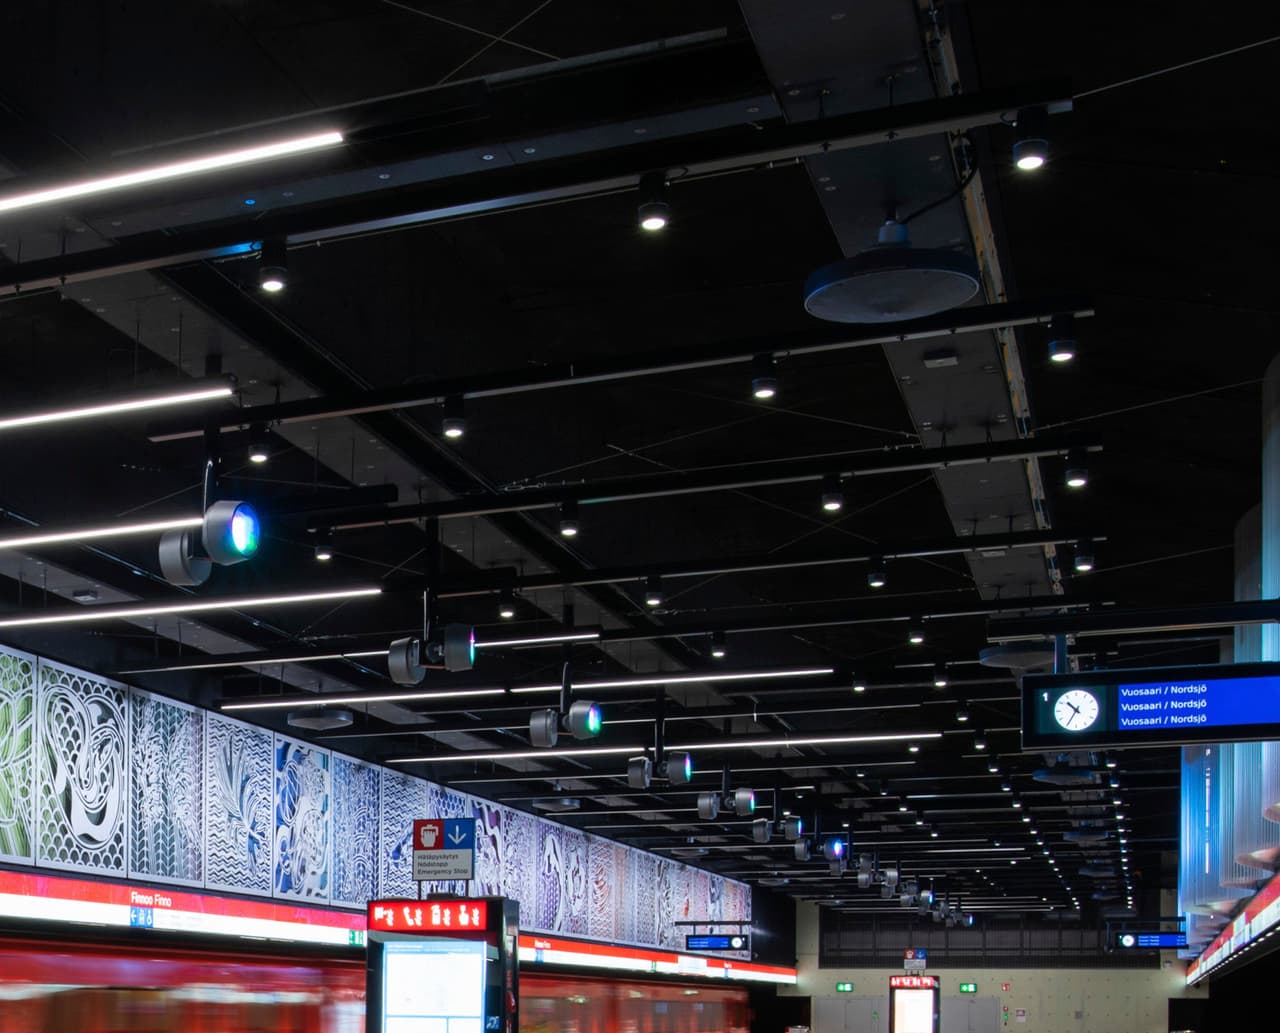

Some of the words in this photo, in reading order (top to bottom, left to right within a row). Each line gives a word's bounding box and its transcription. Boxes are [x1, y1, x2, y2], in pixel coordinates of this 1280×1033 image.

[1121, 687, 1162, 697] Vuosaari
[1170, 684, 1207, 696] Nordsjö
[1042, 692, 1049, 702] 1
[1121, 702, 1162, 711] Vuosaari
[1170, 699, 1207, 711] Nordsjö
[1121, 717, 1162, 726] Vuosaari
[1170, 714, 1207, 726] Nordsjö
